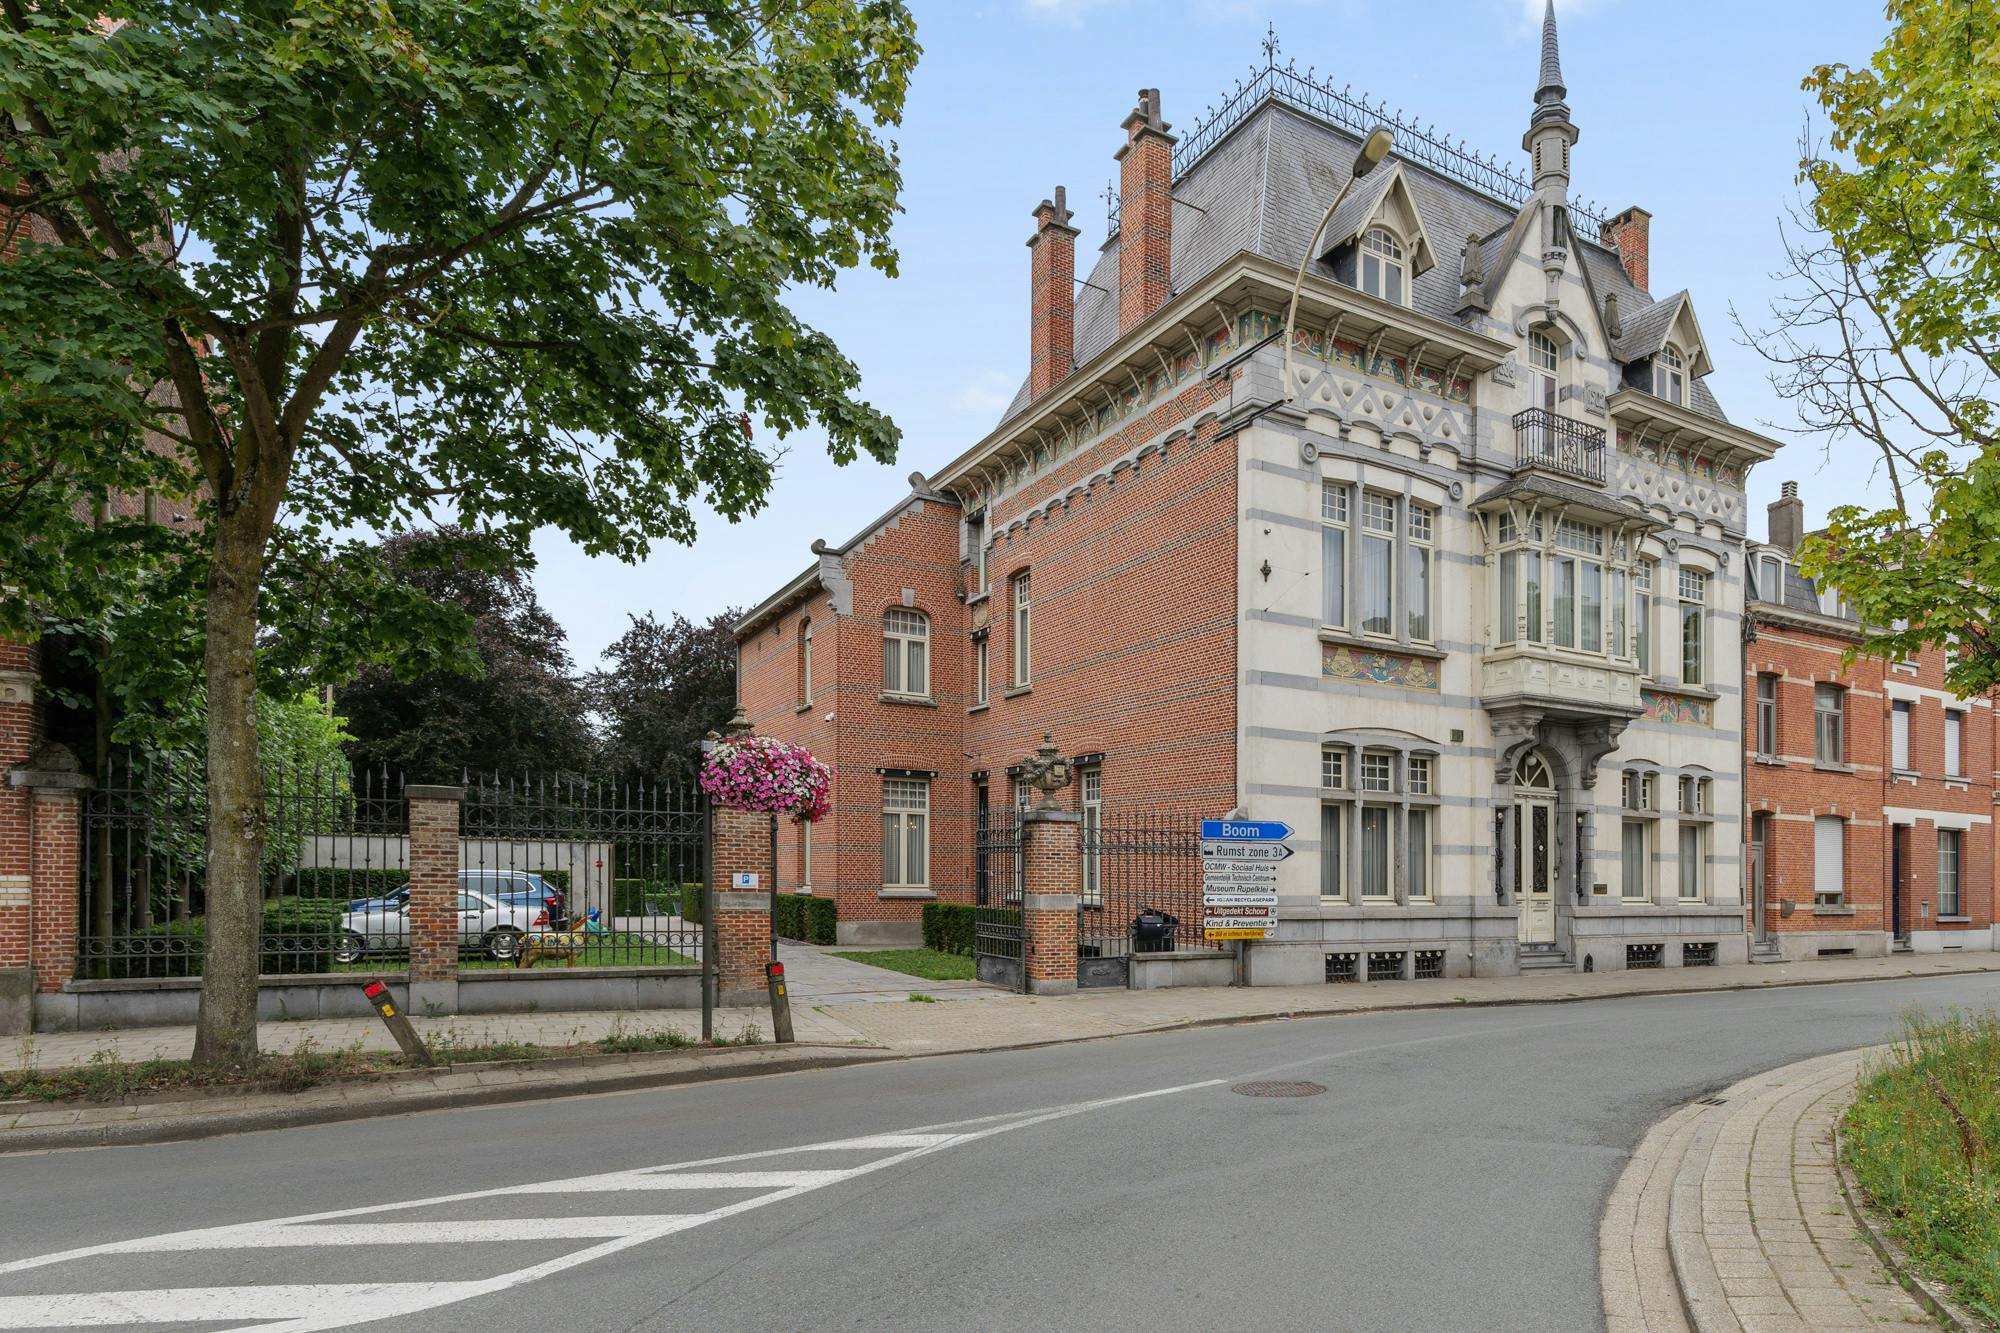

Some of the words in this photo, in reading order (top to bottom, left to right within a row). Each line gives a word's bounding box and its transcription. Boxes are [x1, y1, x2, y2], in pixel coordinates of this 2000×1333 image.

[1222, 823, 1260, 837] Boom
[1216, 845, 1245, 857] Rumst
[1248, 849, 1269, 858] zone
[1272, 846, 1283, 857] 3A
[1205, 862, 1226, 870] OCMW
[1231, 863, 1254, 871] Sociaal
[1255, 864, 1270, 872] Huis
[1231, 873, 1252, 881] Technisch
[1236, 885, 1269, 894] Rupelklei
[1214, 907, 1243, 916] Uitgedekt
[1244, 907, 1267, 915] Schoor
[1205, 919, 1223, 927] Kind
[1232, 919, 1268, 927] Preventie
